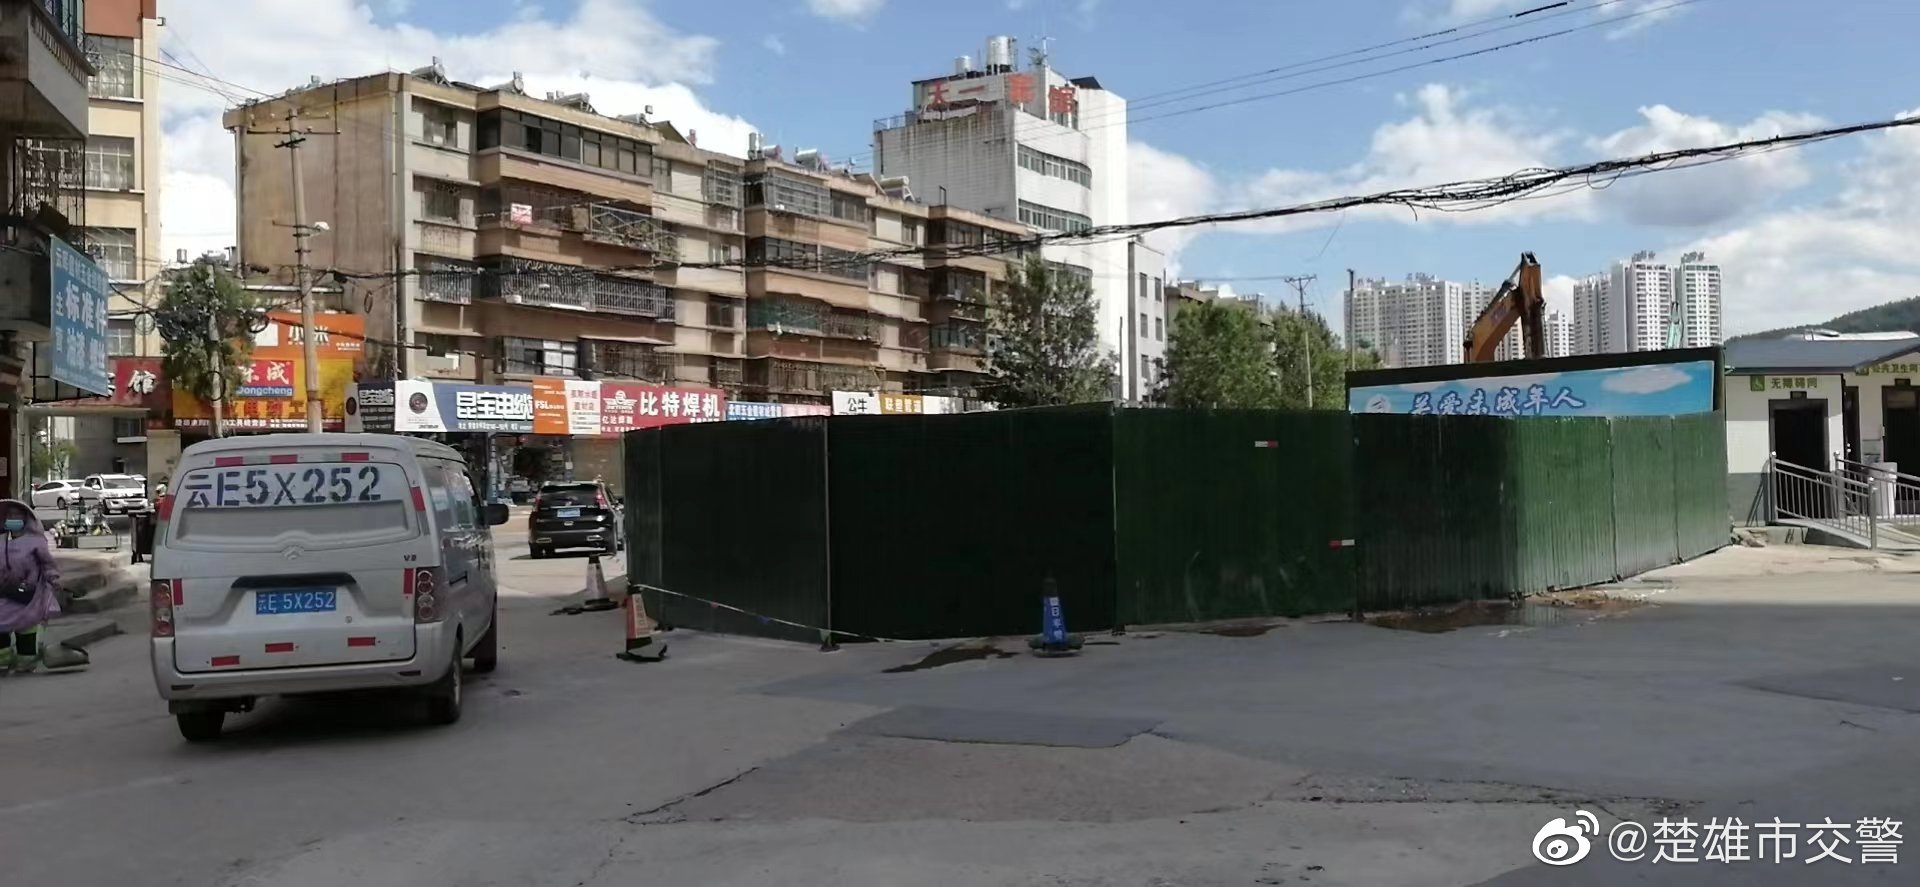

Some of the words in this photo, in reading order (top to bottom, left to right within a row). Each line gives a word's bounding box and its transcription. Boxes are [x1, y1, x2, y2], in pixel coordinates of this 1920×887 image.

[65, 279, 107, 337] 标准件
[456, 391, 534, 420] 昆宝电缆
[639, 391, 721, 418] 比特焊机
[848, 397, 867, 412] 公牛
[1410, 384, 1585, 416] 关爱未成年人
[184, 466, 382, 508] 云E5X252
